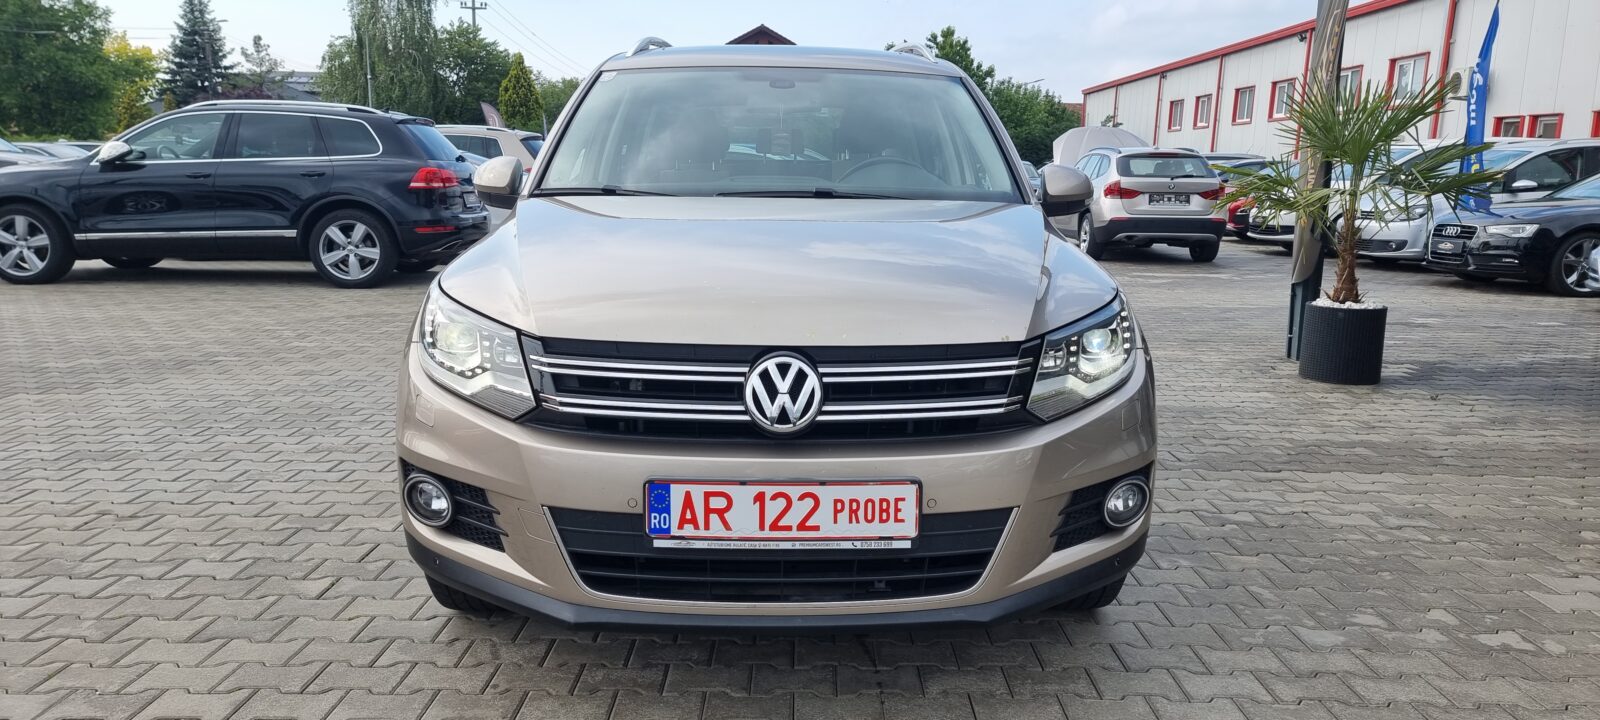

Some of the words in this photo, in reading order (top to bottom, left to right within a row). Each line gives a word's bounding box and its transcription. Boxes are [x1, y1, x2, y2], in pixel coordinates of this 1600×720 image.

[650, 513, 670, 529] RO
[676, 490, 734, 532] AR
[752, 491, 821, 532] 122
[832, 497, 906, 525] PROBE
